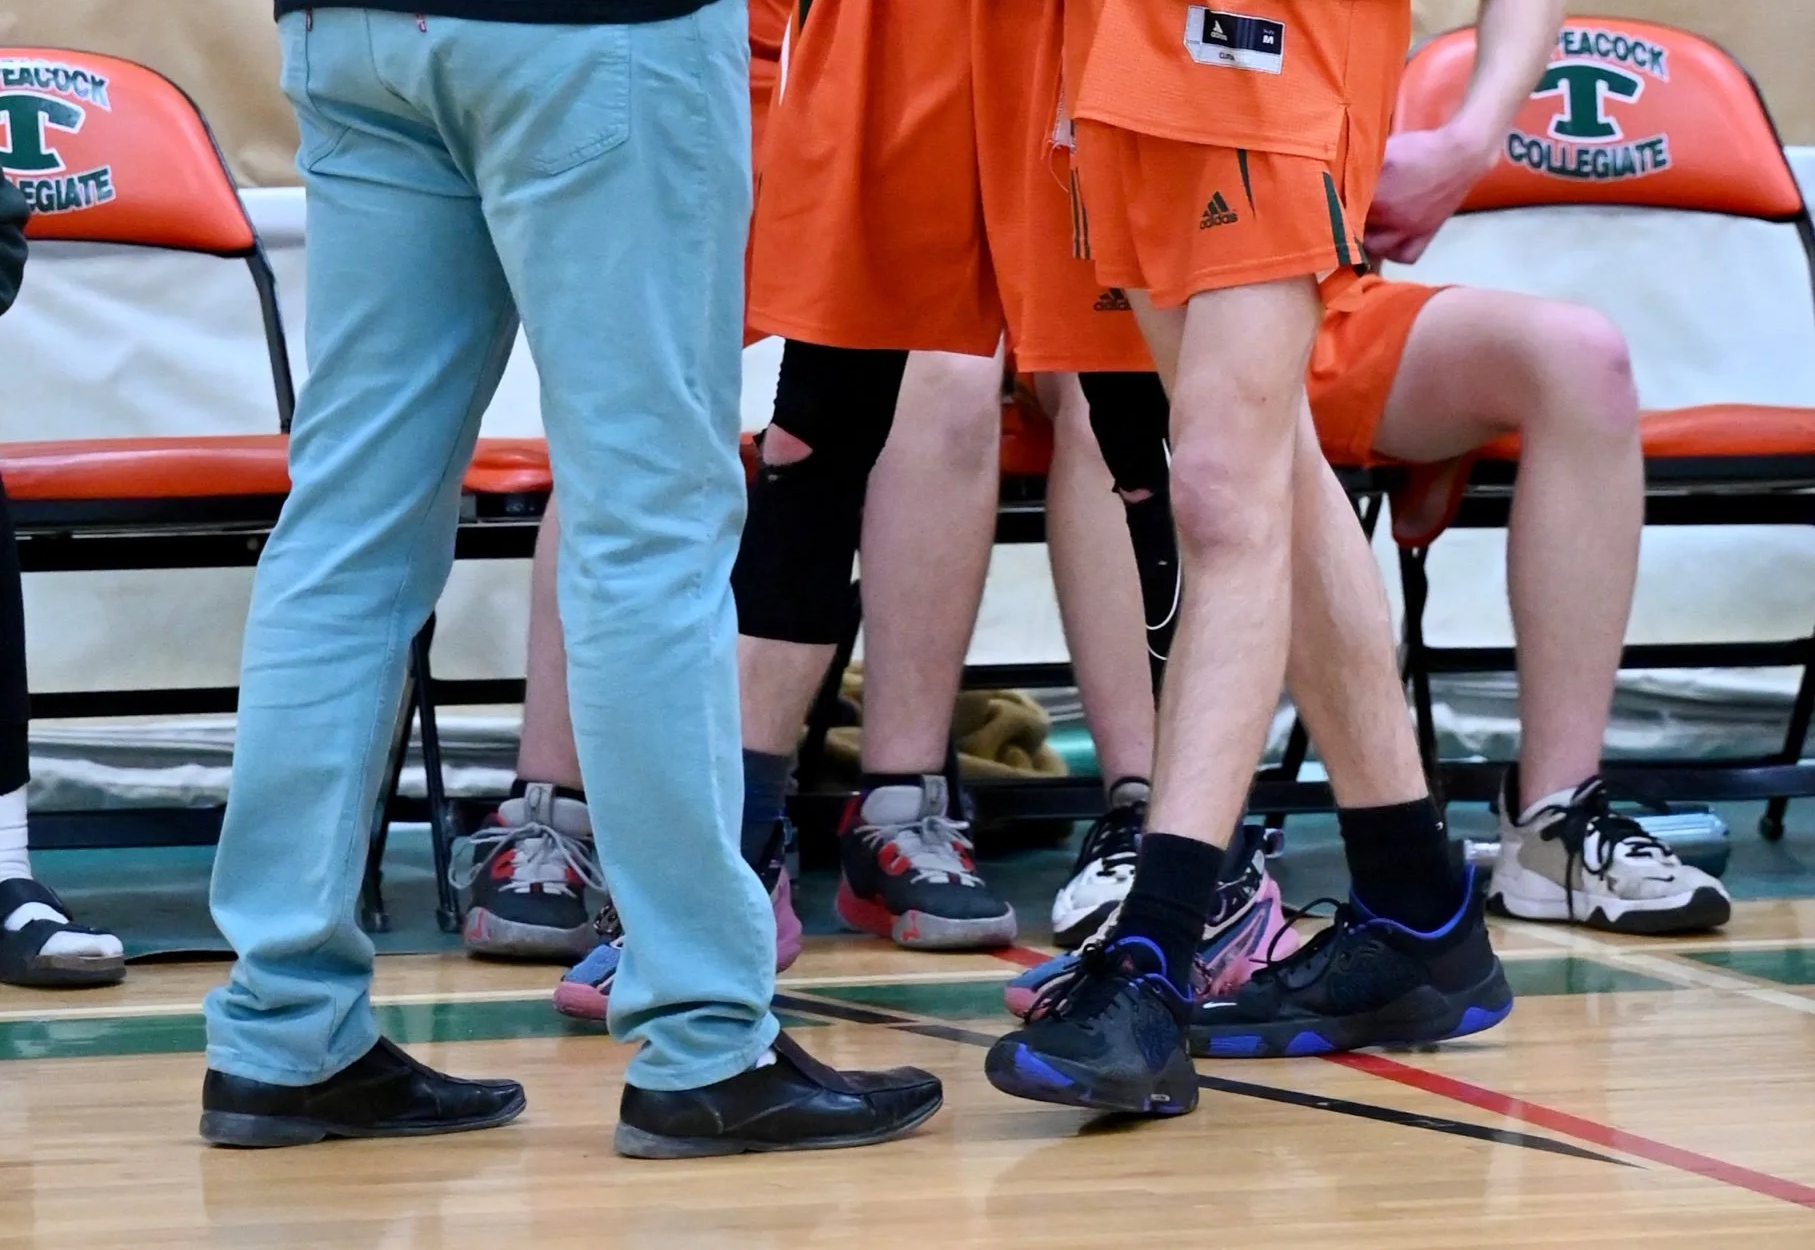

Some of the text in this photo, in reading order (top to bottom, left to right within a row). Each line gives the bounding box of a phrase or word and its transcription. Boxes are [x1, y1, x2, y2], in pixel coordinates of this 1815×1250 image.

[1262, 35, 1275, 45] M
[1556, 30, 1665, 81] EACOCK
[0, 60, 108, 109] EACOCK
[1531, 60, 1643, 142] T
[1507, 132, 1668, 180] COLLEGIATE
